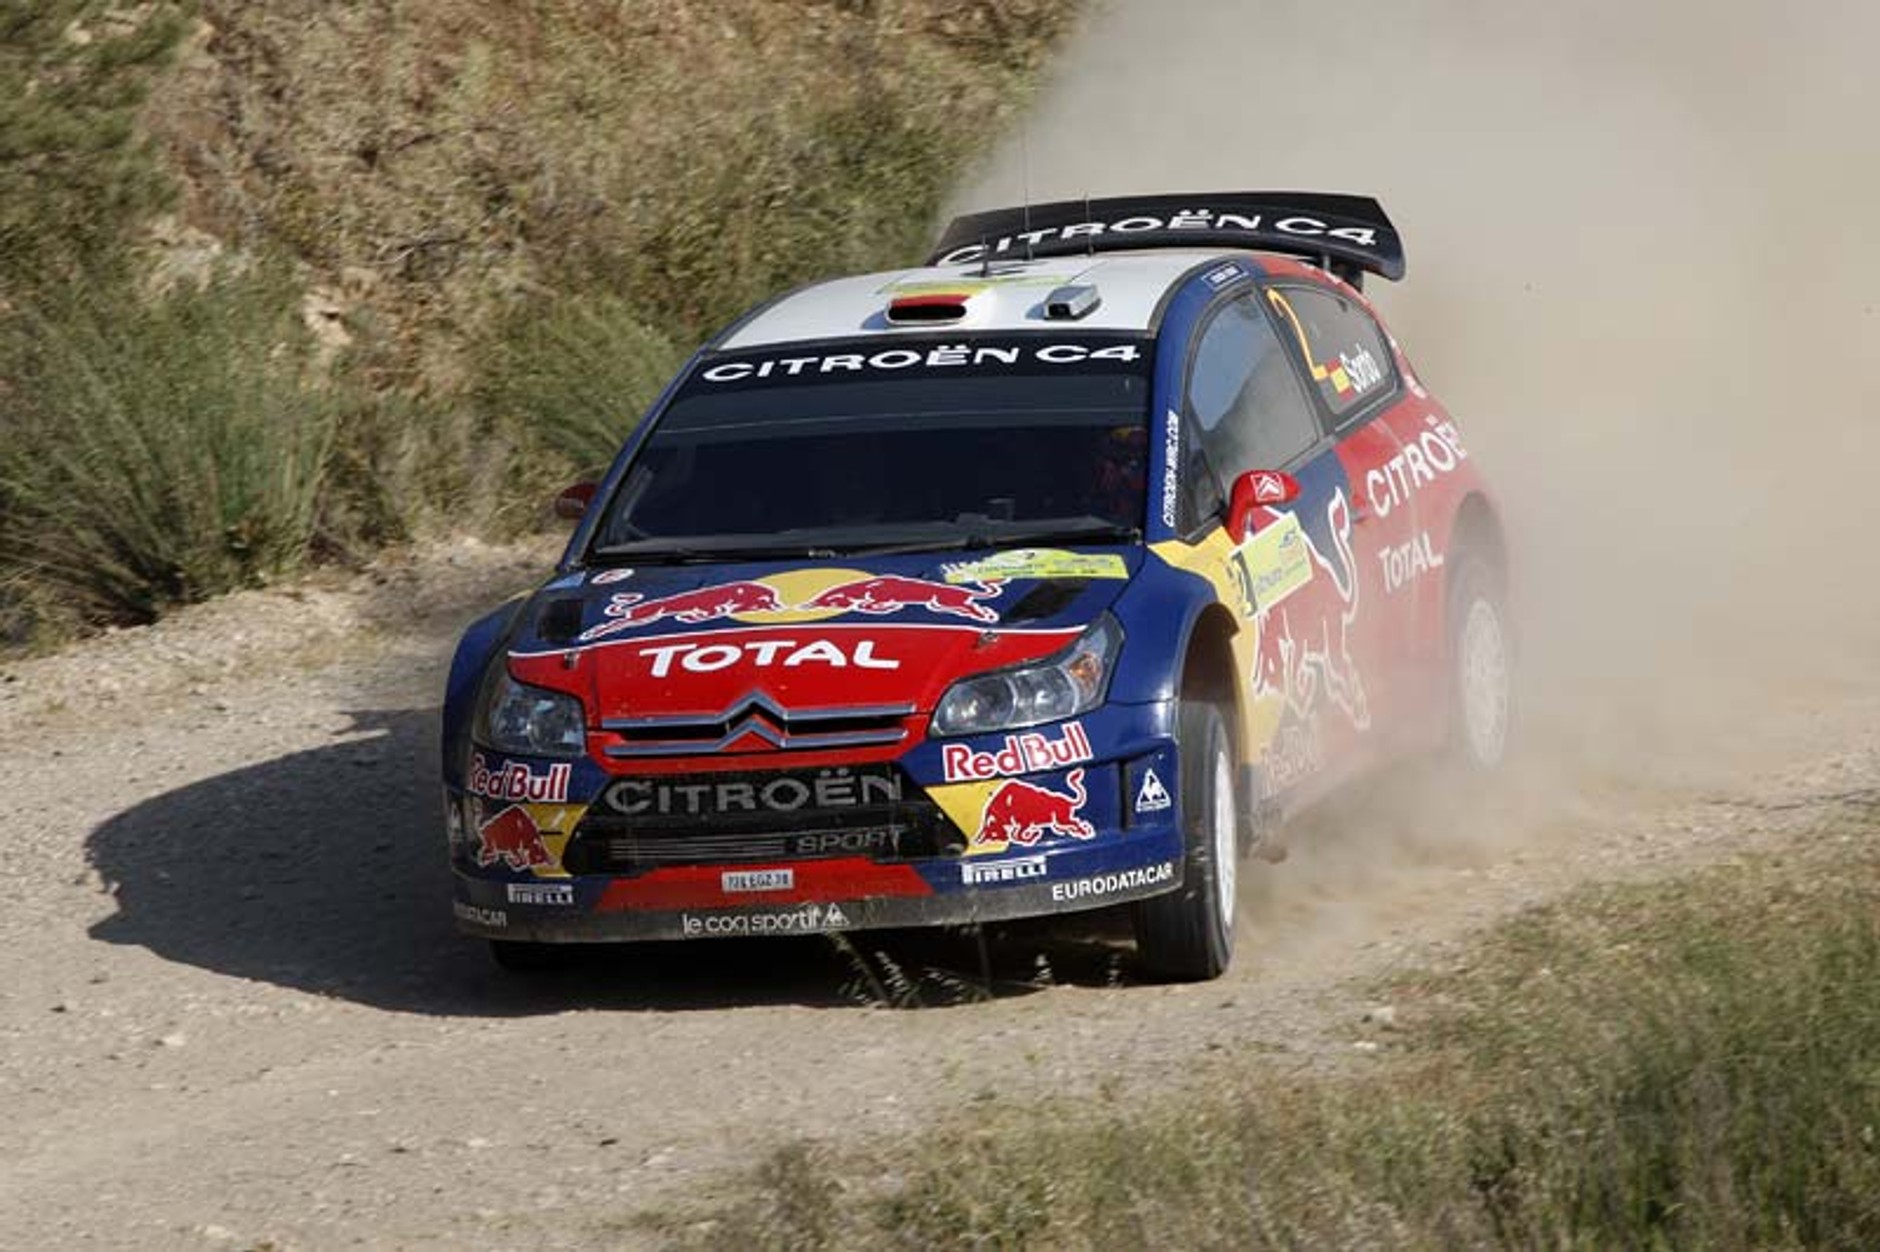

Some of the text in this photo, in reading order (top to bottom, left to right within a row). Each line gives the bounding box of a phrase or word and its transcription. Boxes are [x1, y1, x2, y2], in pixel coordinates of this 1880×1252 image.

[935, 209, 1378, 265] CITROËN C4
[702, 344, 1141, 382] CITROËN C4
[1378, 531, 1444, 593] TOTAL
[638, 640, 901, 678] TOTAL
[943, 721, 1095, 782] Red Bull
[503, 760, 571, 802] Bull
[605, 768, 903, 814] CITROËN
[796, 824, 906, 854] SPORT
[962, 856, 1047, 885] PIRELLI
[1052, 861, 1175, 901] EURODATACAR
[507, 882, 573, 903] PIRELLI
[682, 901, 822, 936] le coq sportif
